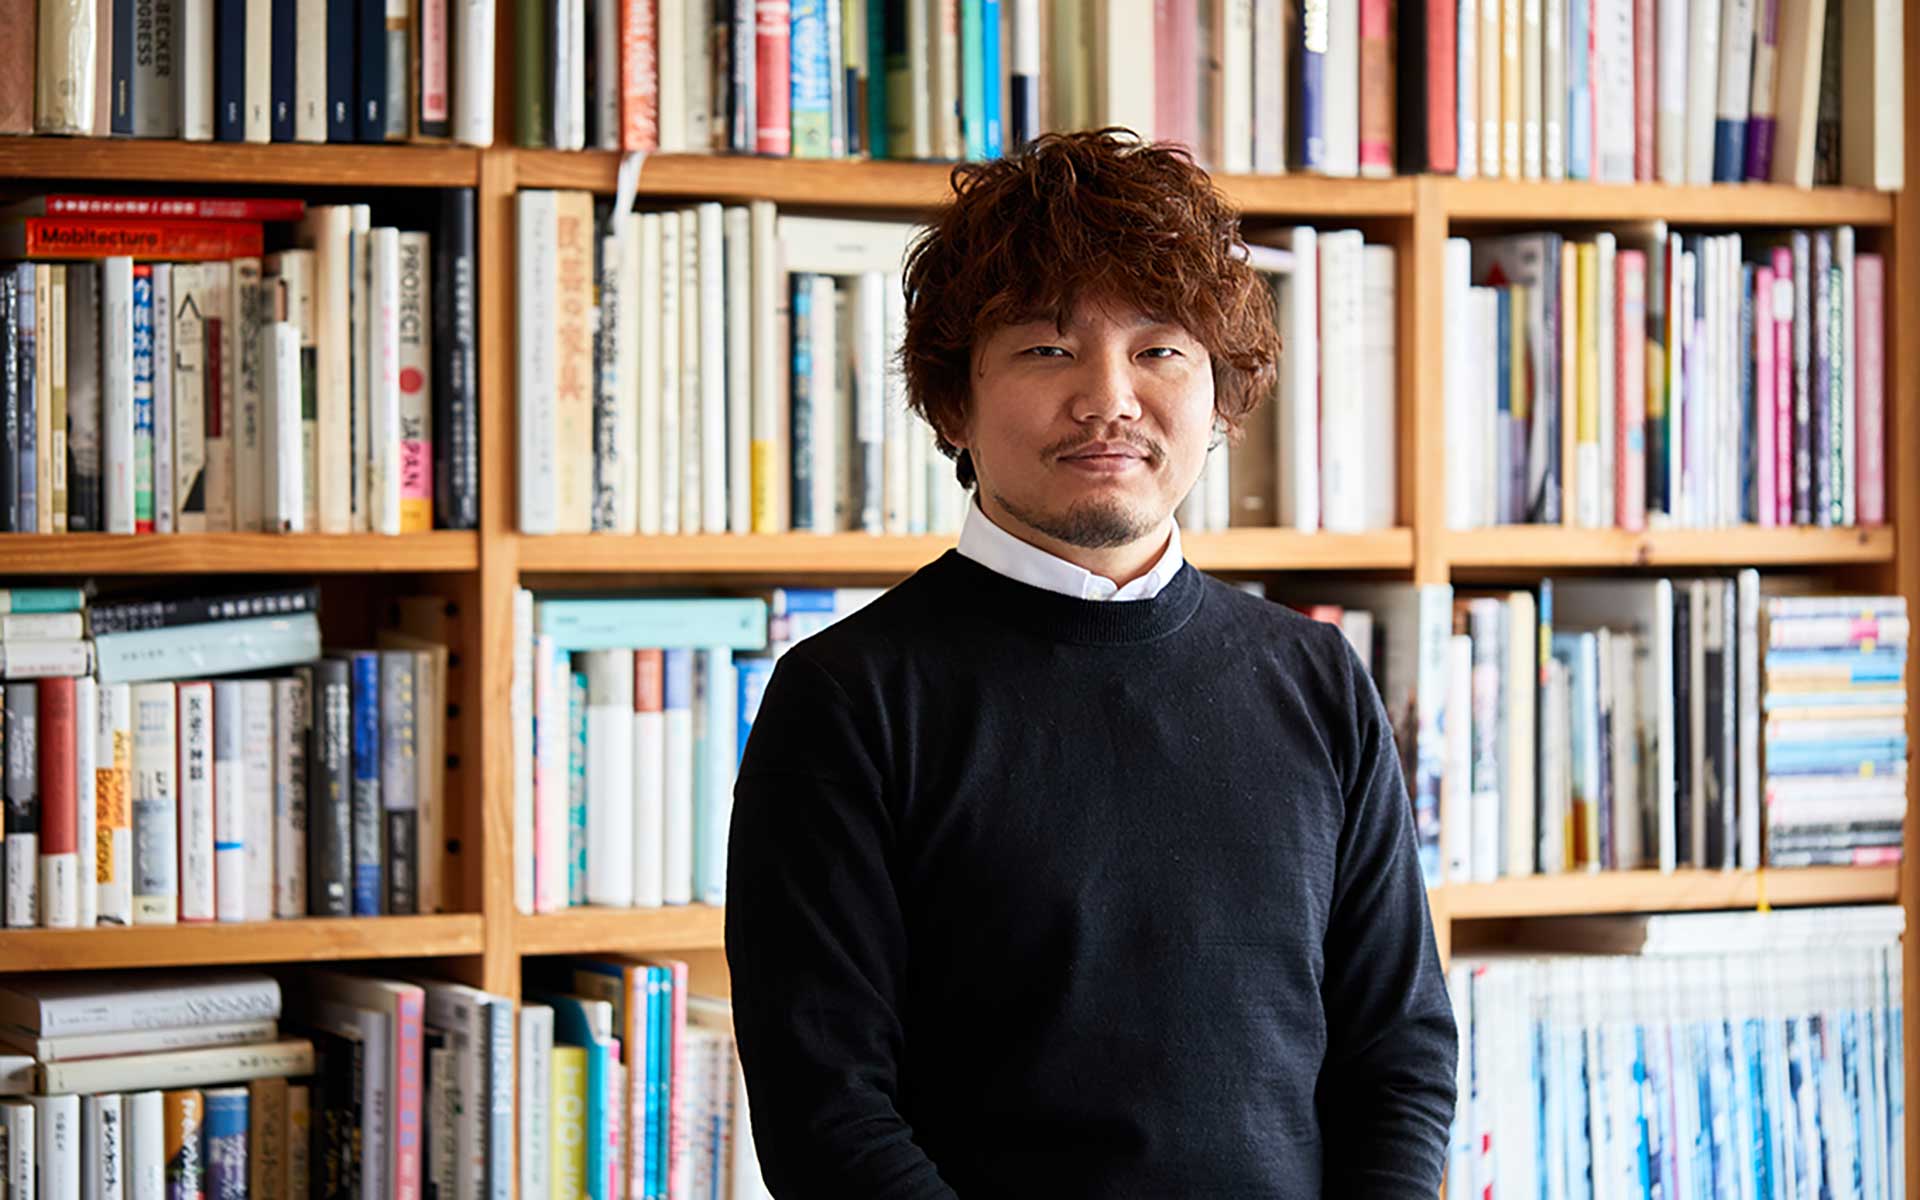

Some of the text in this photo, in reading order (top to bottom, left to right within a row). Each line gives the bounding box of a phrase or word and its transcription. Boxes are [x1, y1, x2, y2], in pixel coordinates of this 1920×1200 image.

[41, 227, 157, 246] Mobitecture
[401, 244, 420, 344] PROJECT
[402, 415, 420, 487] JAPAN
